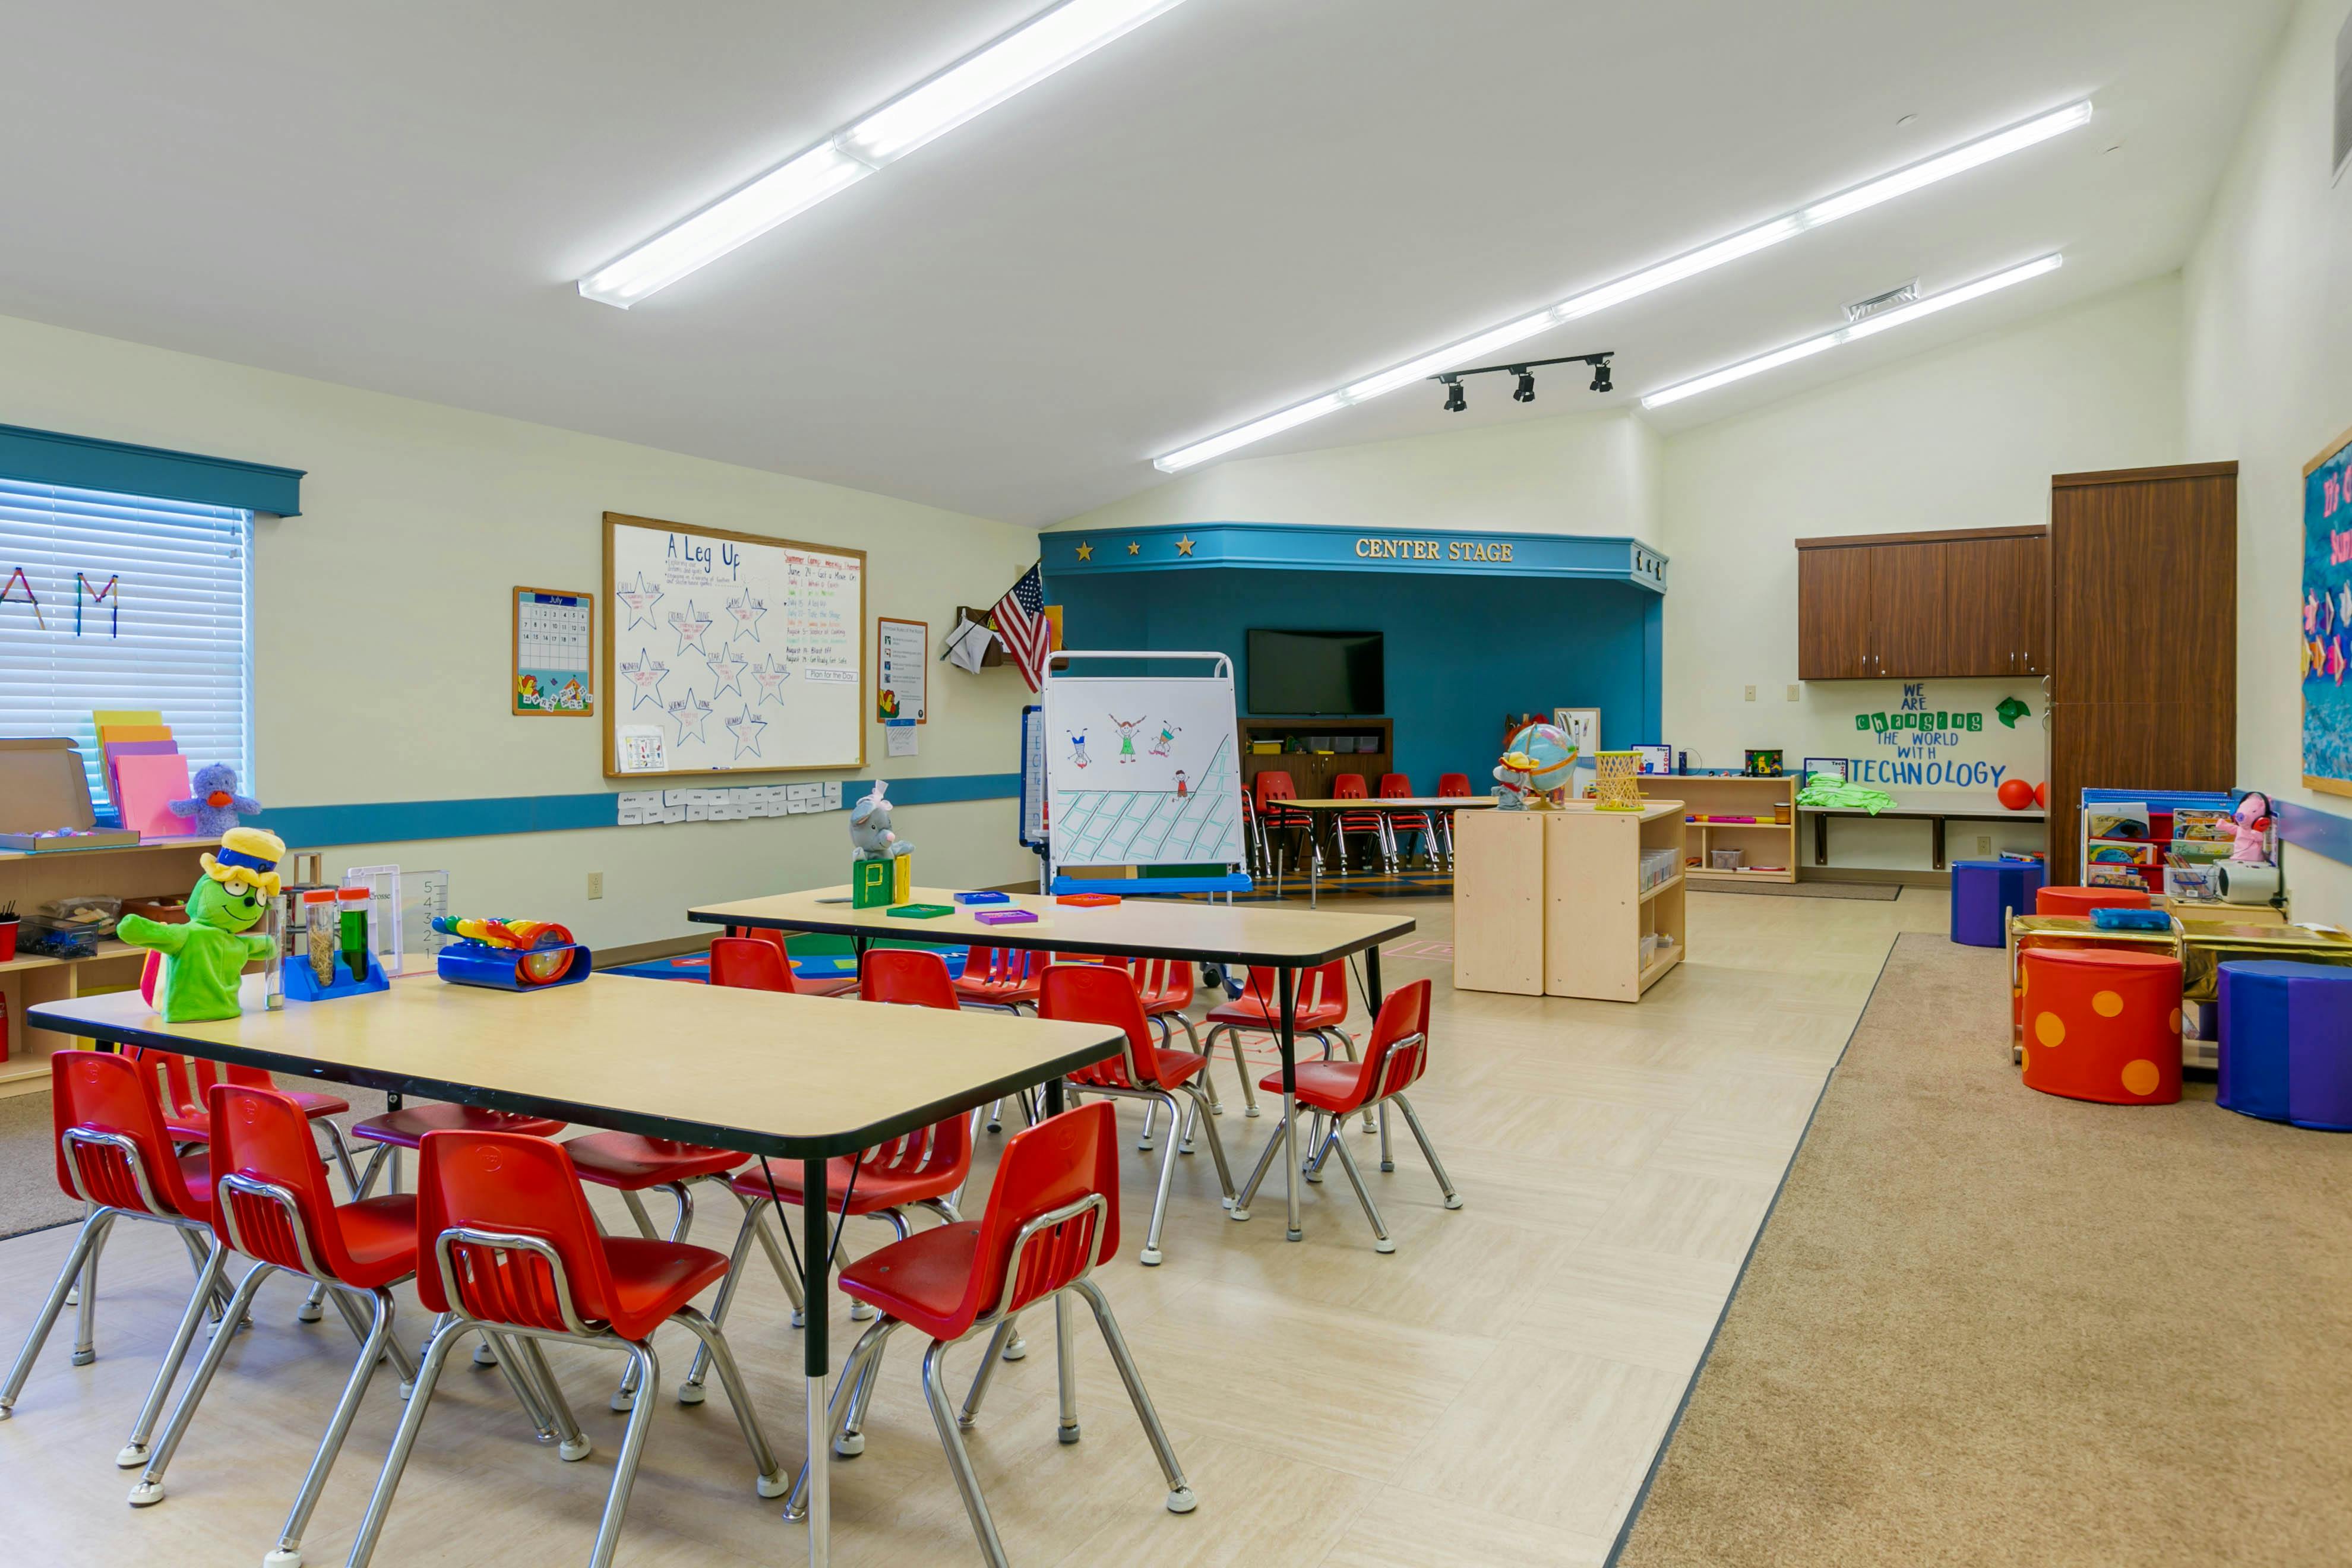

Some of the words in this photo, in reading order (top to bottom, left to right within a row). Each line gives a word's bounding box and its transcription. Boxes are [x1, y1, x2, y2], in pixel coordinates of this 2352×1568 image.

[1355, 538, 1440, 559] CENTER
[1448, 542, 1513, 562] STAGE
[668, 533, 677, 558] A
[685, 535, 711, 573] Leg
[722, 543, 740, 581] Up
[783, 550, 804, 564] Summer
[788, 564, 801, 577] June
[617, 581, 635, 593] CHILL
[646, 582, 661, 593] ZONE
[549, 596, 563, 605] July
[751, 598, 764, 608] ZONE
[697, 611, 710, 621] ZONE
[707, 653, 720, 662] STAR
[731, 653, 745, 662] ZONE
[652, 661, 665, 670] ZONE
[775, 663, 788, 672] ZONE
[842, 672, 854, 680] Day
[1904, 683, 1925, 697] WE
[698, 700, 711, 709] ZONE
[1901, 697, 1927, 710] ARE
[1876, 732, 1899, 745] THE
[1912, 732, 1959, 746] WORLD
[1897, 746, 1936, 760] WITH
[1850, 760, 2006, 788] TECHNOLOGY
[423, 881, 433, 893] 5
[865, 864, 884, 903] P
[423, 897, 433, 908] 4
[423, 912, 432, 924] 3
[423, 930, 432, 942] 2
[424, 948, 429, 959] 1
